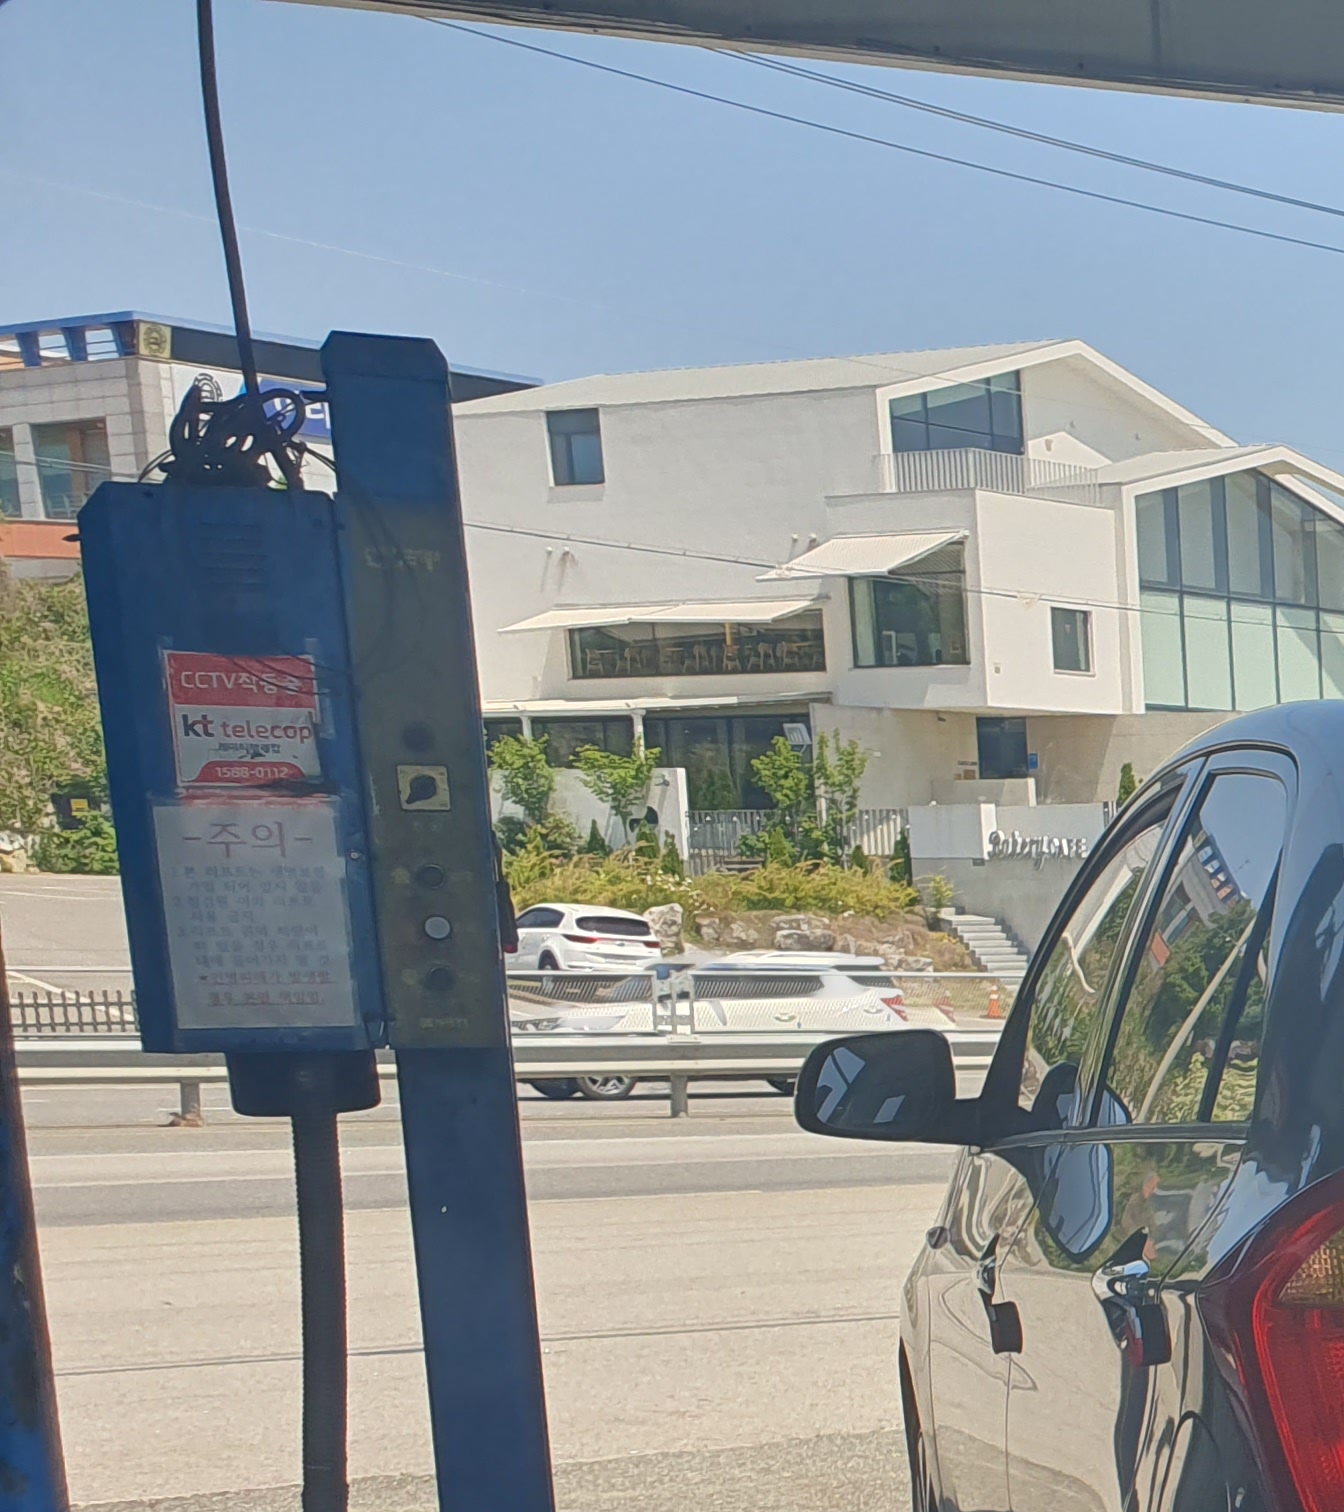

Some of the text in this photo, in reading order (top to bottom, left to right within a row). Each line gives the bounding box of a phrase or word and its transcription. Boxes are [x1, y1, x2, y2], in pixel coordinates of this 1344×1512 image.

[181, 714, 312, 744] kt telecop
[215, 766, 289, 778] 1588-0112
